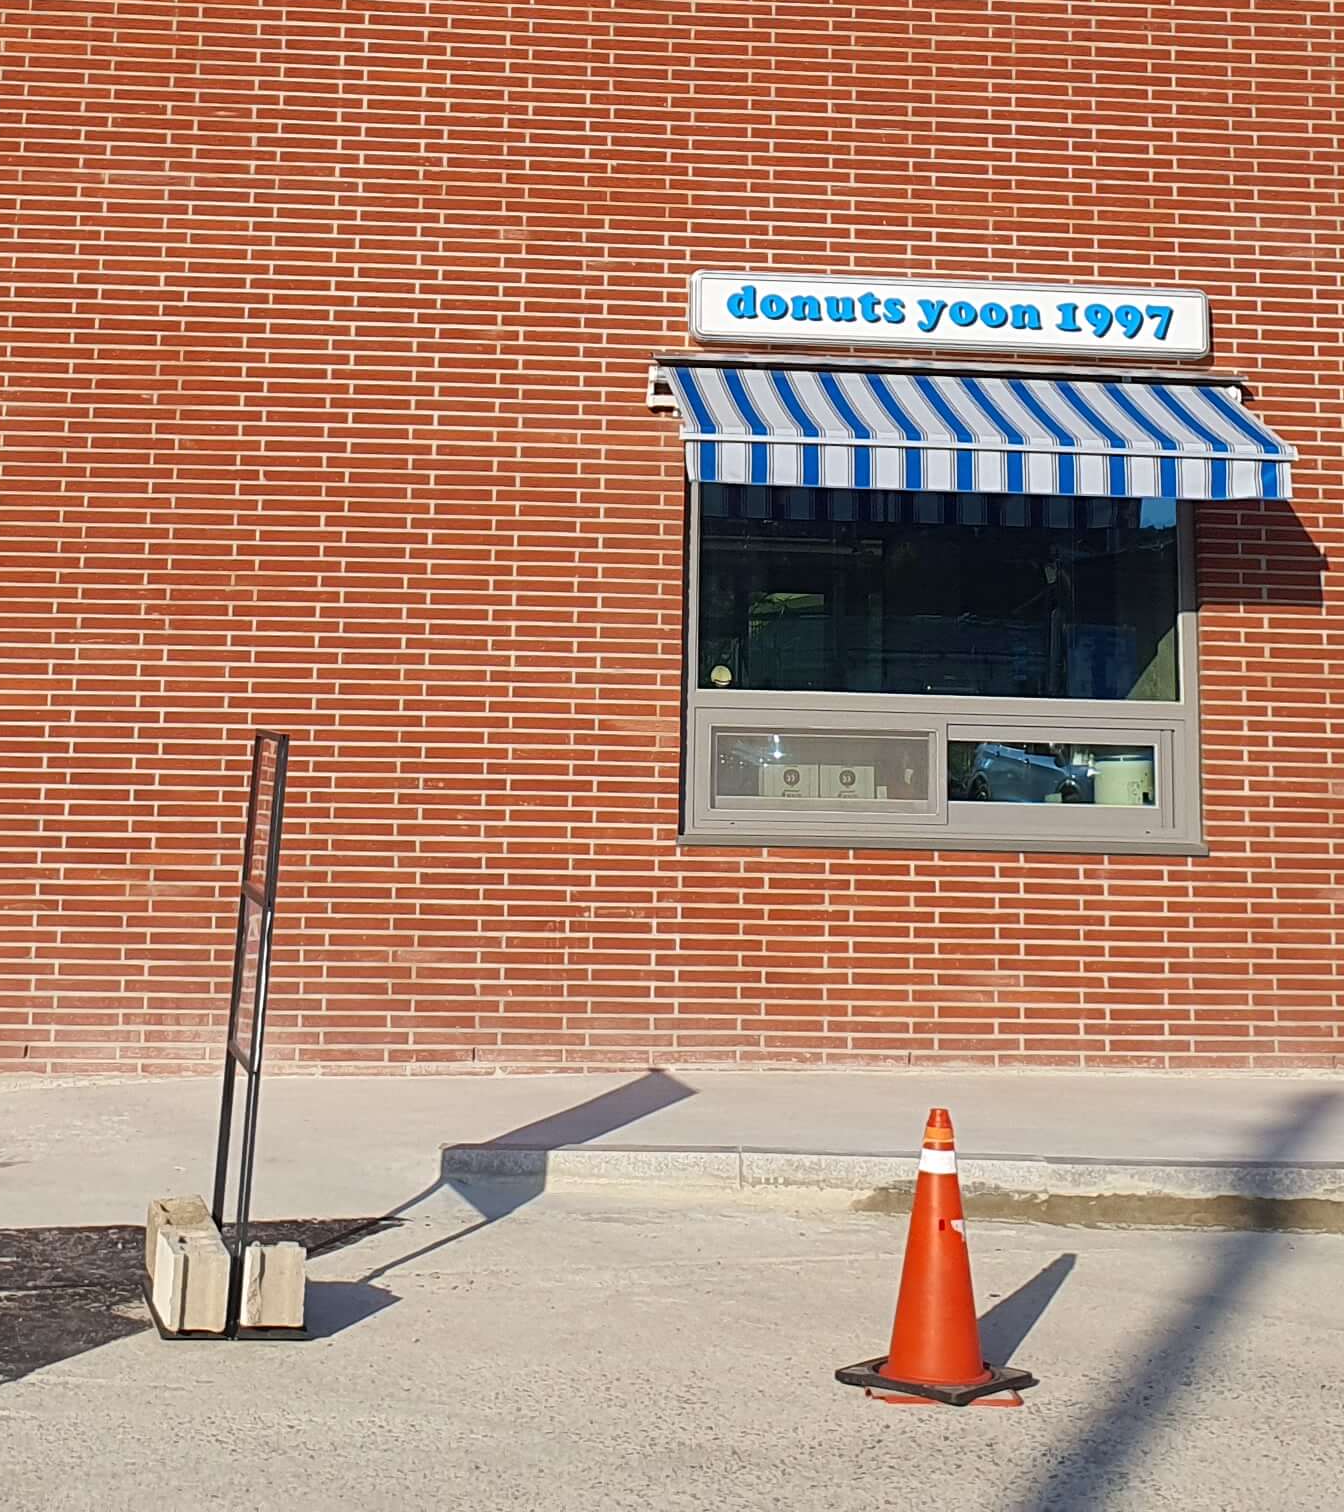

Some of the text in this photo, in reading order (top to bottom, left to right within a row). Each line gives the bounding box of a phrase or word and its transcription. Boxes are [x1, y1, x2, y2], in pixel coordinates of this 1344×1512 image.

[727, 285, 1174, 340] donuts yoon 1997
